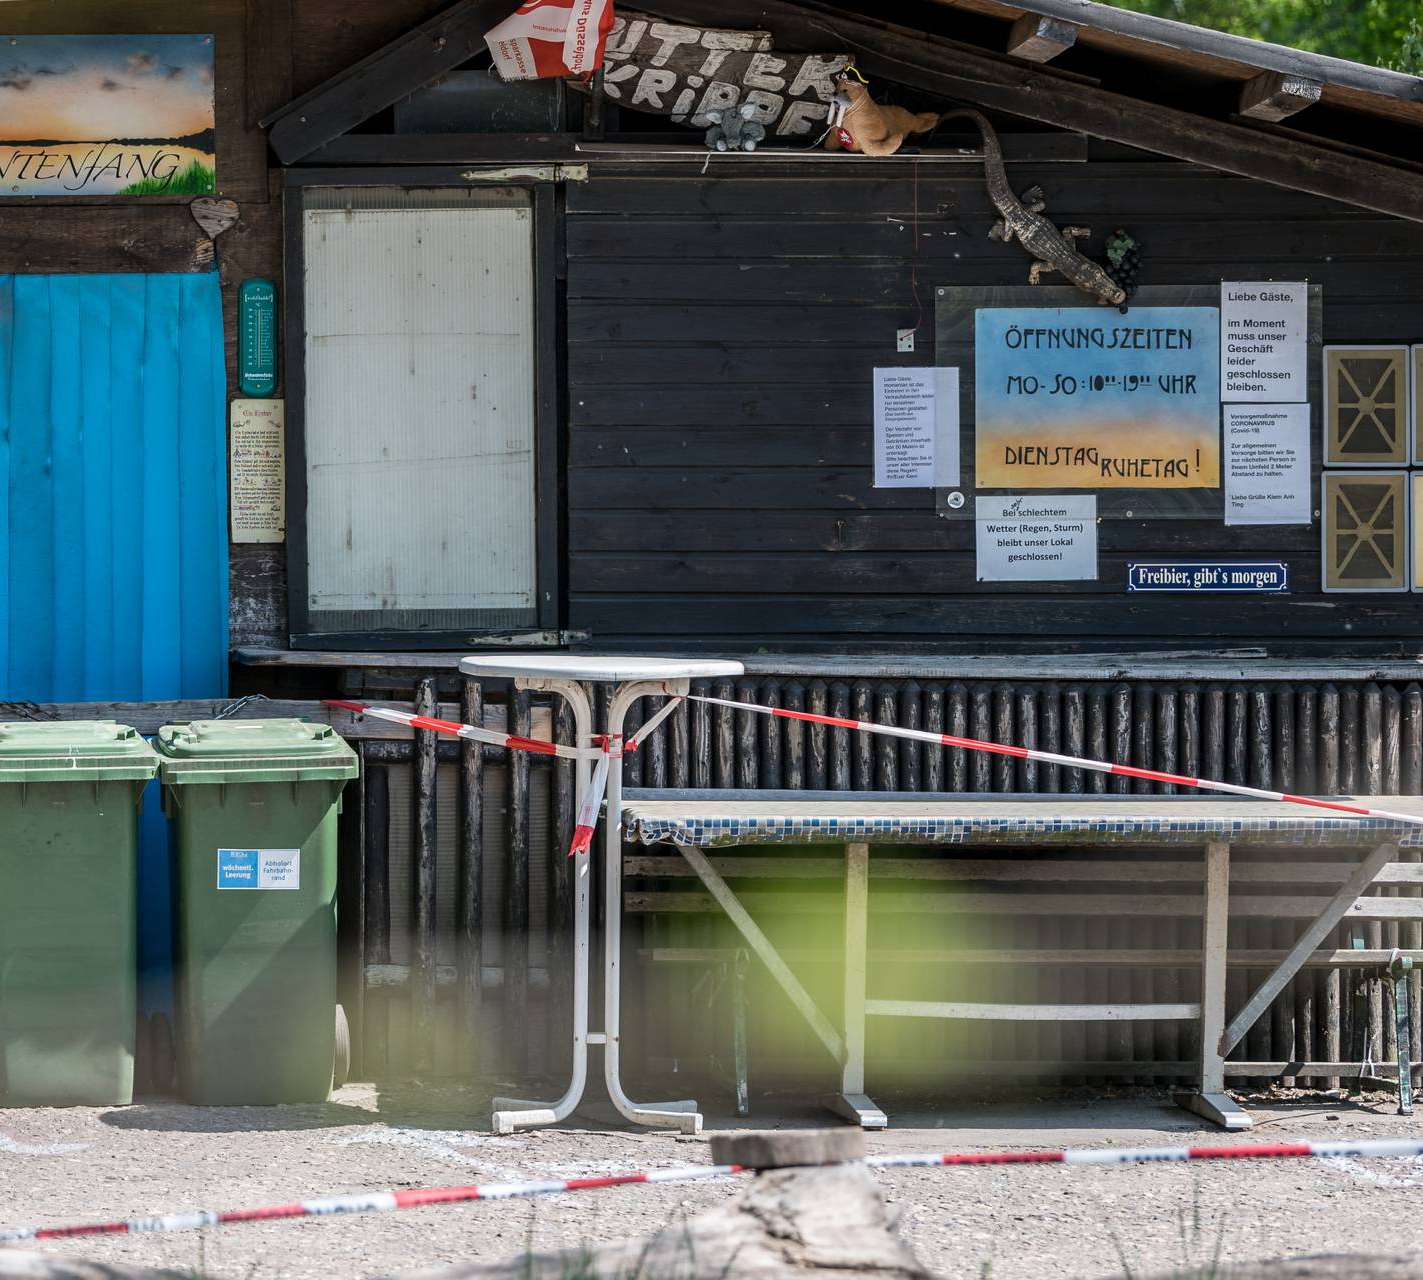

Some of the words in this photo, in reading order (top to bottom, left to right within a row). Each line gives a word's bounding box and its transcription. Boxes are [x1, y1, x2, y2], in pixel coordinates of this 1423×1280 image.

[1228, 292, 1257, 302] Liebe
[1260, 291, 1294, 303] Gäste,
[1228, 319, 1240, 328] im
[1243, 319, 1286, 328] Moment
[1005, 325, 1193, 350] ÖFFNUNGSZEITEN
[1228, 333, 1255, 341] muss
[1258, 333, 1287, 341] unser
[1227, 344, 1274, 354] Geschäft
[1227, 356, 1256, 366] leider
[1226, 369, 1291, 380] geschlossen
[1158, 374, 1197, 394] UHR
[1226, 382, 1267, 392] bleiben.
[1242, 442, 1277, 450] allgemeinen
[1005, 446, 1099, 466] DIENSTAG
[1100, 458, 1190, 478] RUHETAG
[1002, 508, 1016, 517] Bei
[1017, 508, 1067, 517] schlechtem
[986, 524, 1018, 533] Wetter
[1019, 524, 1052, 534] (Regen,
[1053, 523, 1083, 533] Sturm)
[997, 538, 1022, 547] bleibt
[1024, 539, 1049, 547] unser
[1050, 538, 1074, 546] Lokal
[1008, 552, 1063, 563] geschlossen!
[1138, 567, 1191, 587] Freibier,
[1231, 571, 1278, 588] morgen
[225, 871, 252, 879] Leerung
[263, 867, 294, 875] Fahrbahn-
